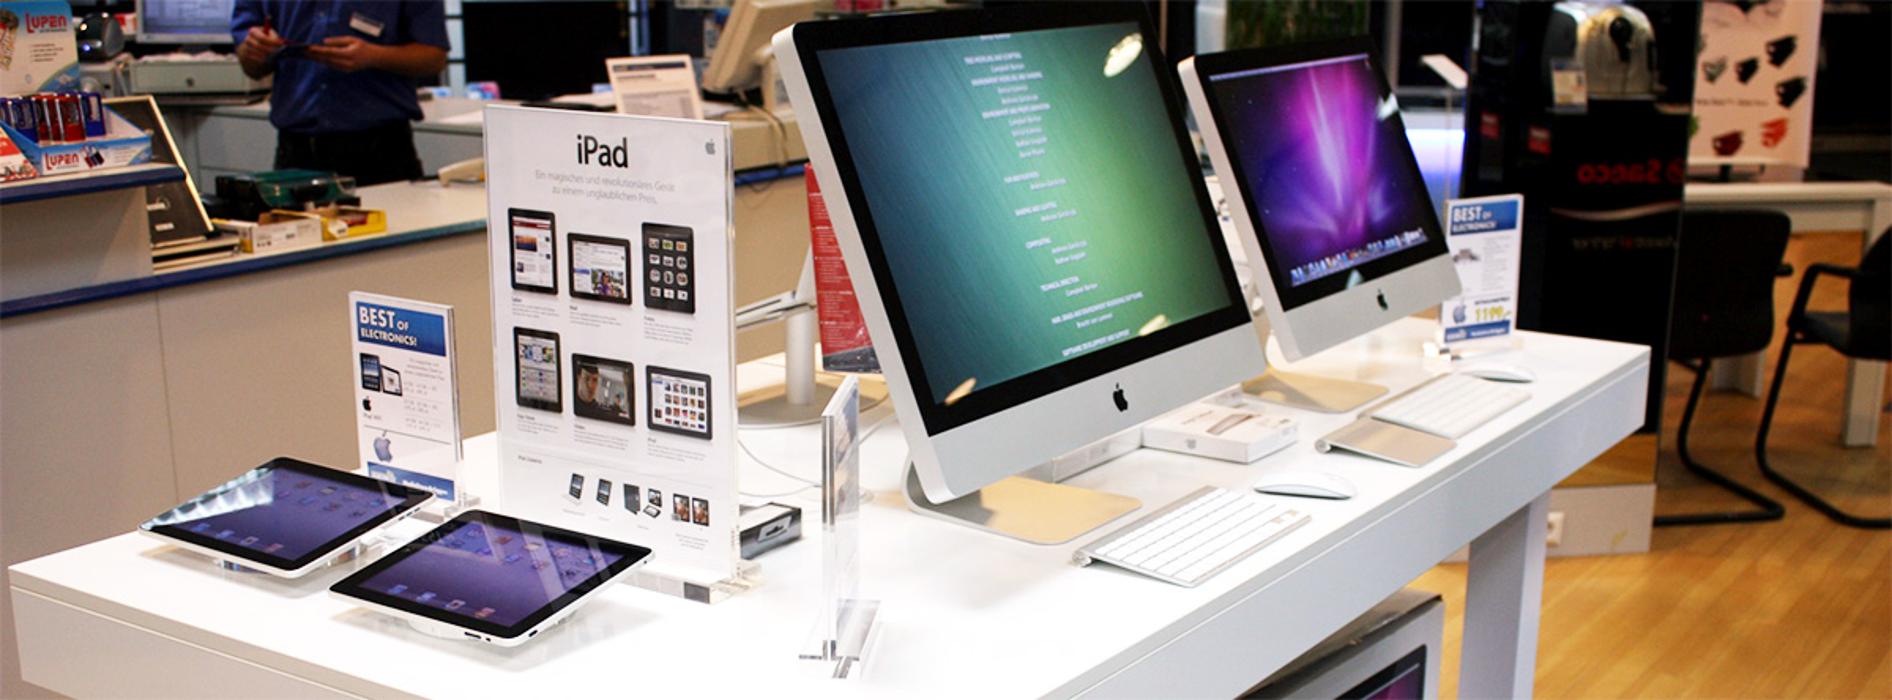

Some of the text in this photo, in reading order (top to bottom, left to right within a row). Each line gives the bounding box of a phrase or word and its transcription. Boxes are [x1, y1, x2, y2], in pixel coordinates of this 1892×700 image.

[576, 134, 629, 168] iPad
[1453, 206, 1483, 223] BEST
[359, 306, 409, 331] BEST OF
[360, 328, 418, 347] ELECTRONICS!
